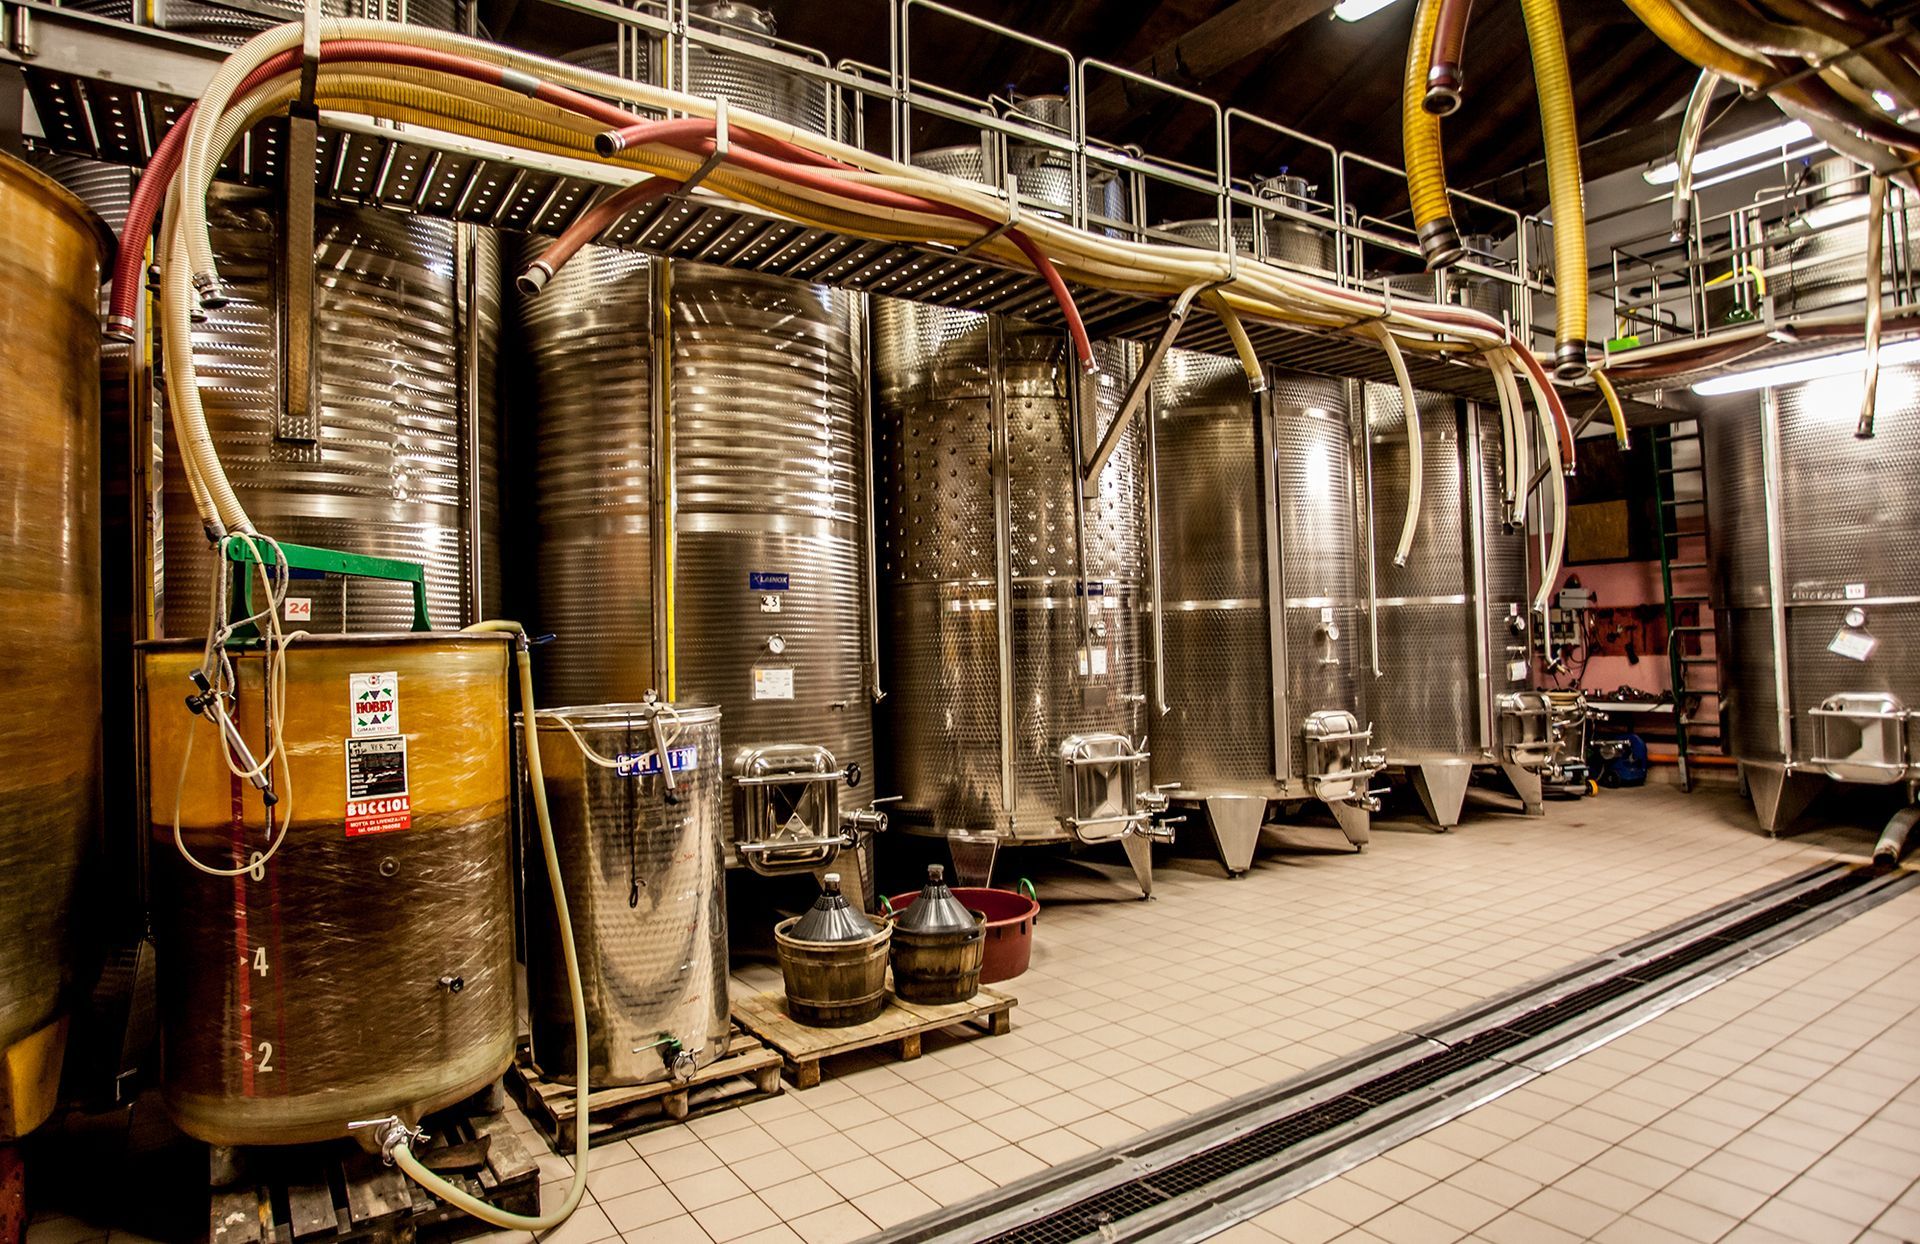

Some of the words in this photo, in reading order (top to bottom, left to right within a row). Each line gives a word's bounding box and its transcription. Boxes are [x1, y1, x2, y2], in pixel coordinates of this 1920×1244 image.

[289, 602, 309, 614] 24
[356, 700, 394, 714] HOBBY
[347, 798, 409, 816] BUCCIOL
[253, 947, 269, 976] 4
[258, 1042, 273, 1072] 2
